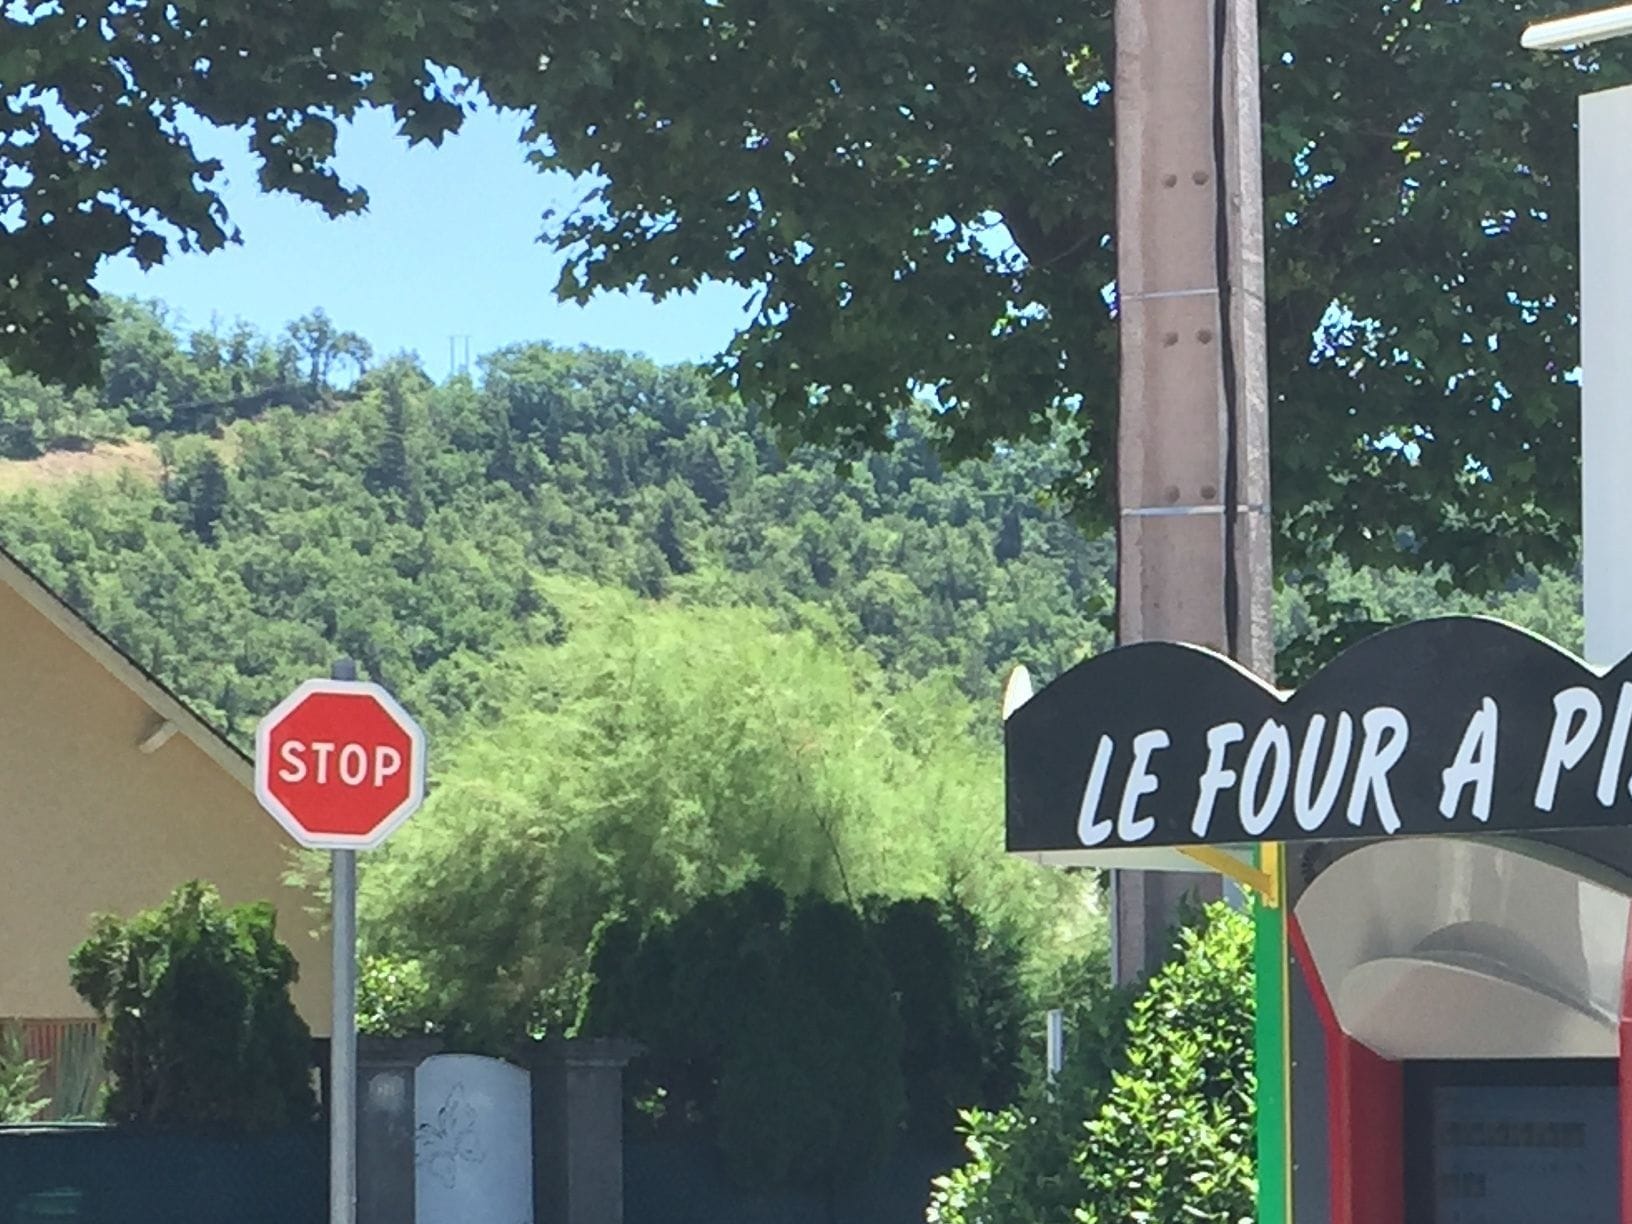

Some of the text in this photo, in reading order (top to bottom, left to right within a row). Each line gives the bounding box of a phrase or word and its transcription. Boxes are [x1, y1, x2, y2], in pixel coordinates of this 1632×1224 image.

[278, 740, 402, 787] STOP
[1077, 730, 1170, 846] LE
[1191, 706, 1410, 837] FOUR
[1440, 696, 1499, 821] A
